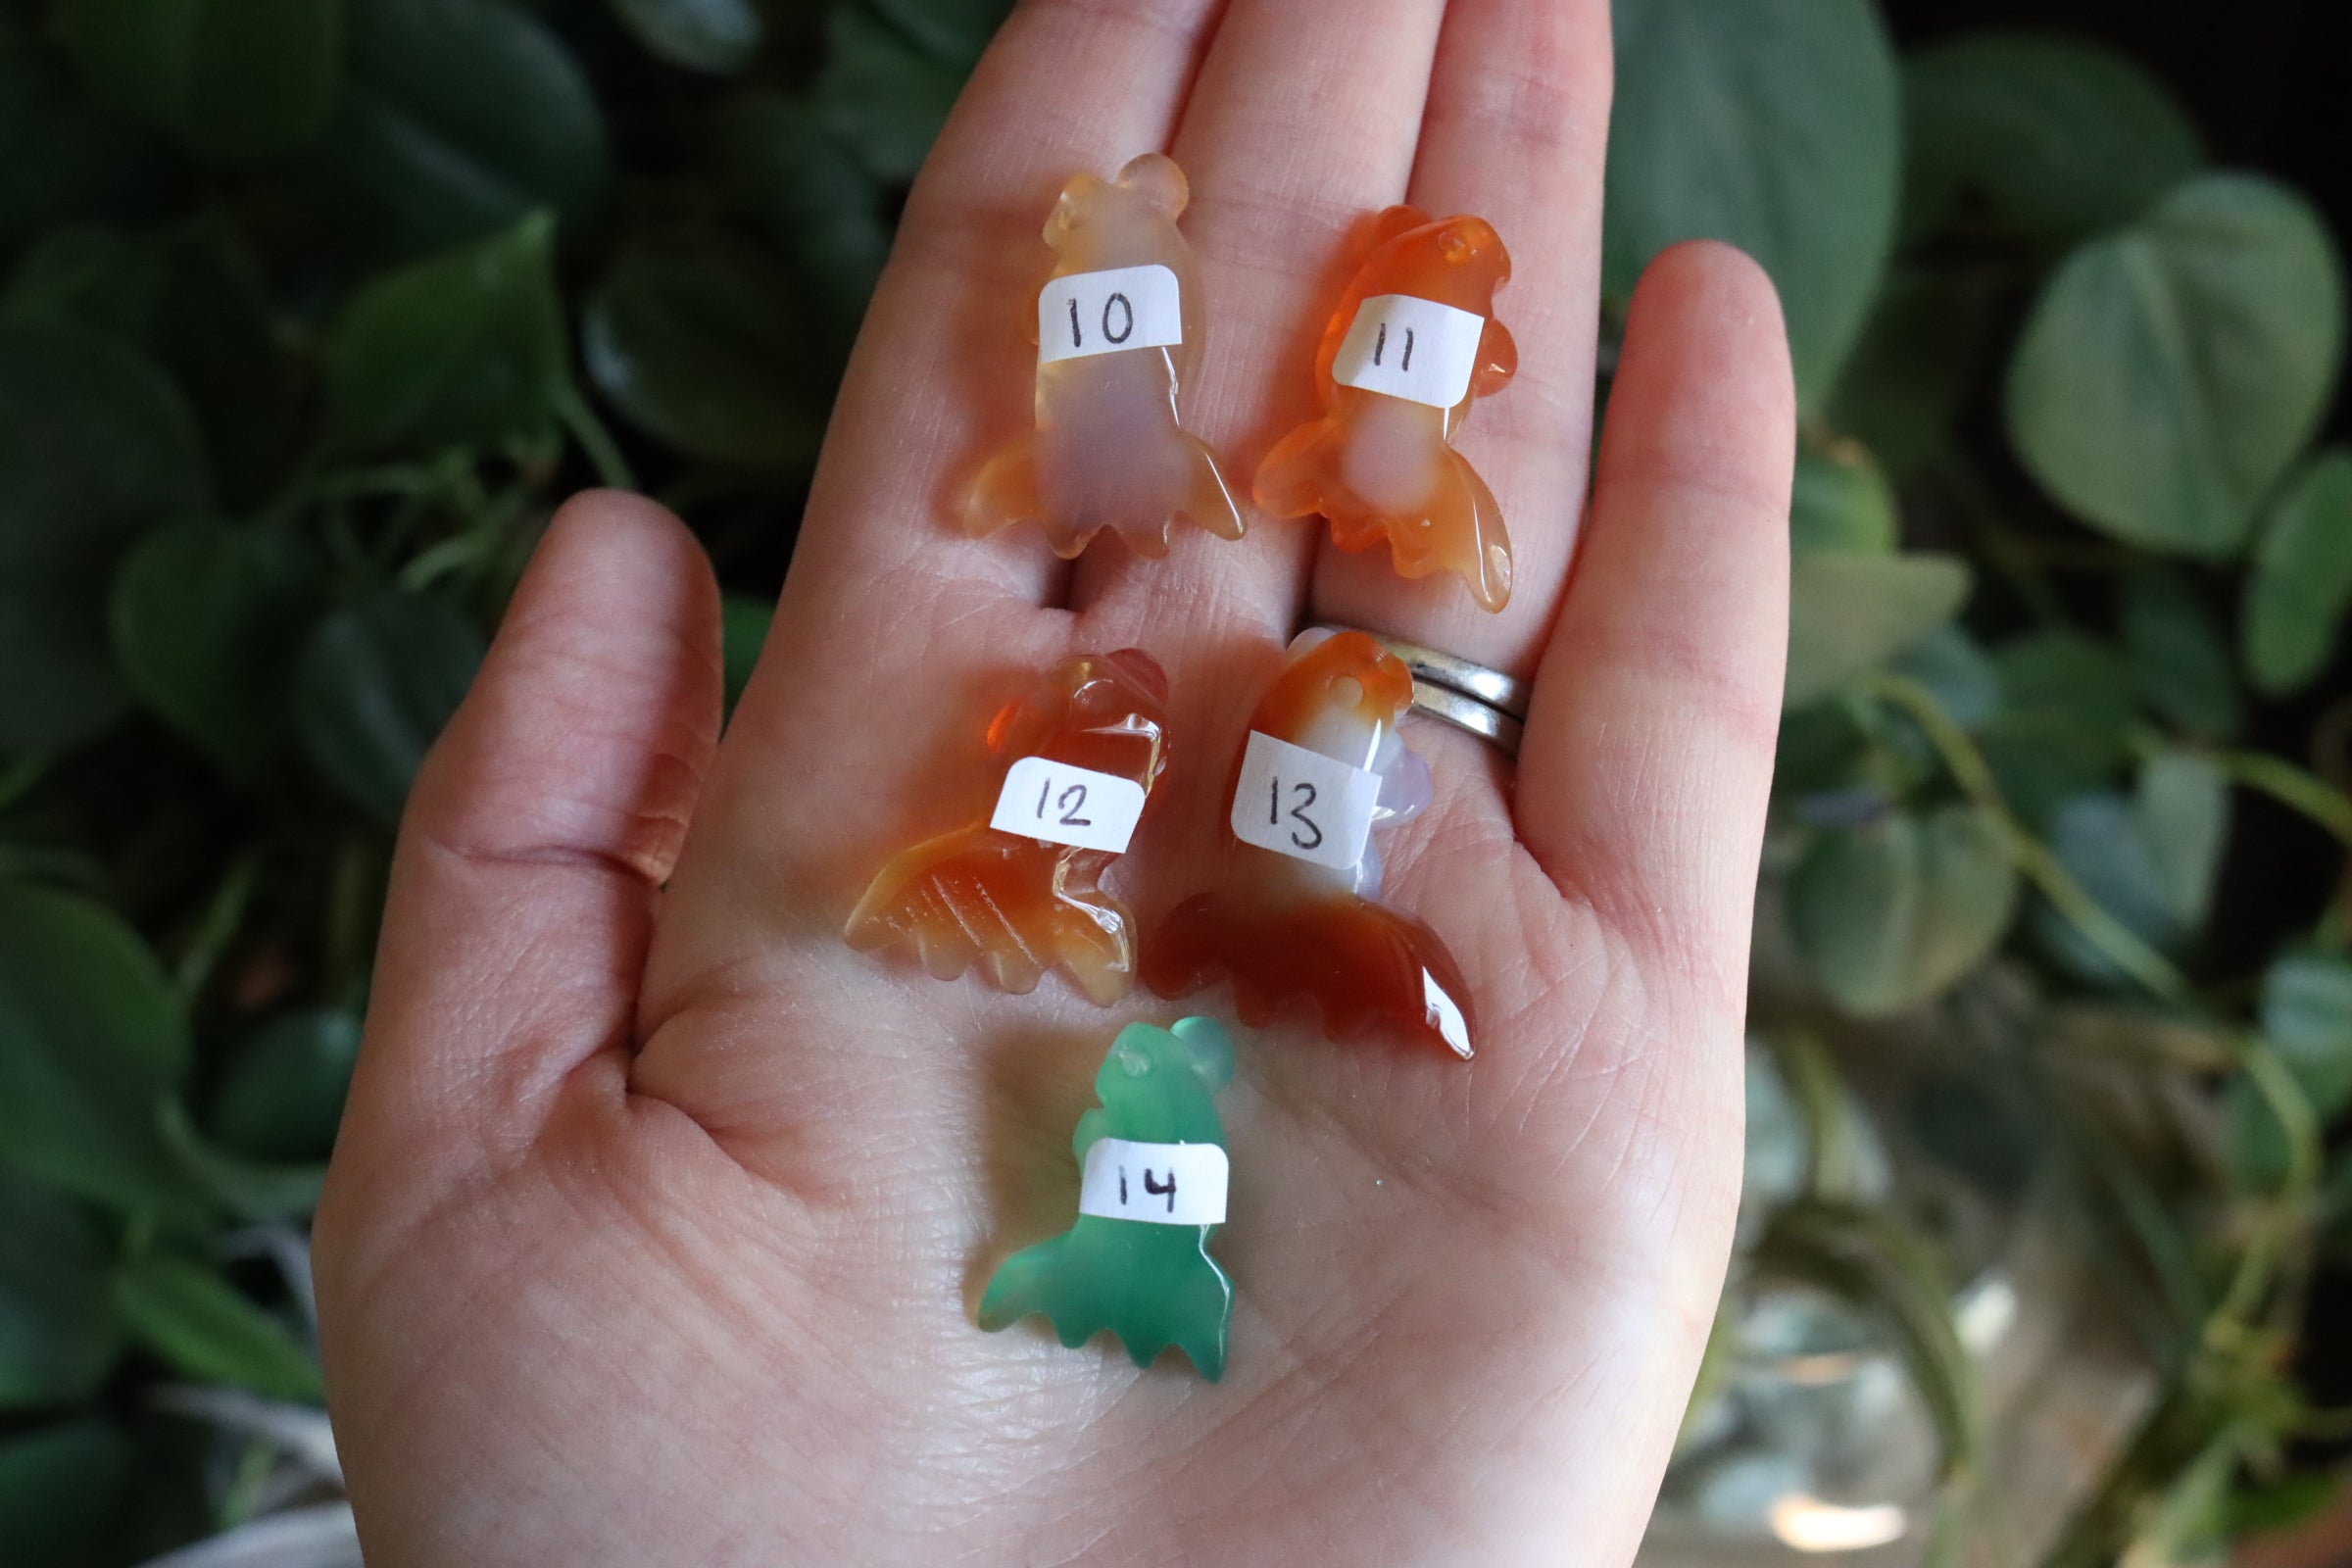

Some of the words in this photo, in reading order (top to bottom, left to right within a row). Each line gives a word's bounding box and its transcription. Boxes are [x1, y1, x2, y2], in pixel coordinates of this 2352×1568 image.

[1067, 292, 1133, 348] 10
[1374, 322, 1414, 371] 11
[1036, 776, 1091, 826] 12
[1269, 775, 1323, 851] 13
[1119, 1165, 1177, 1213] 14
